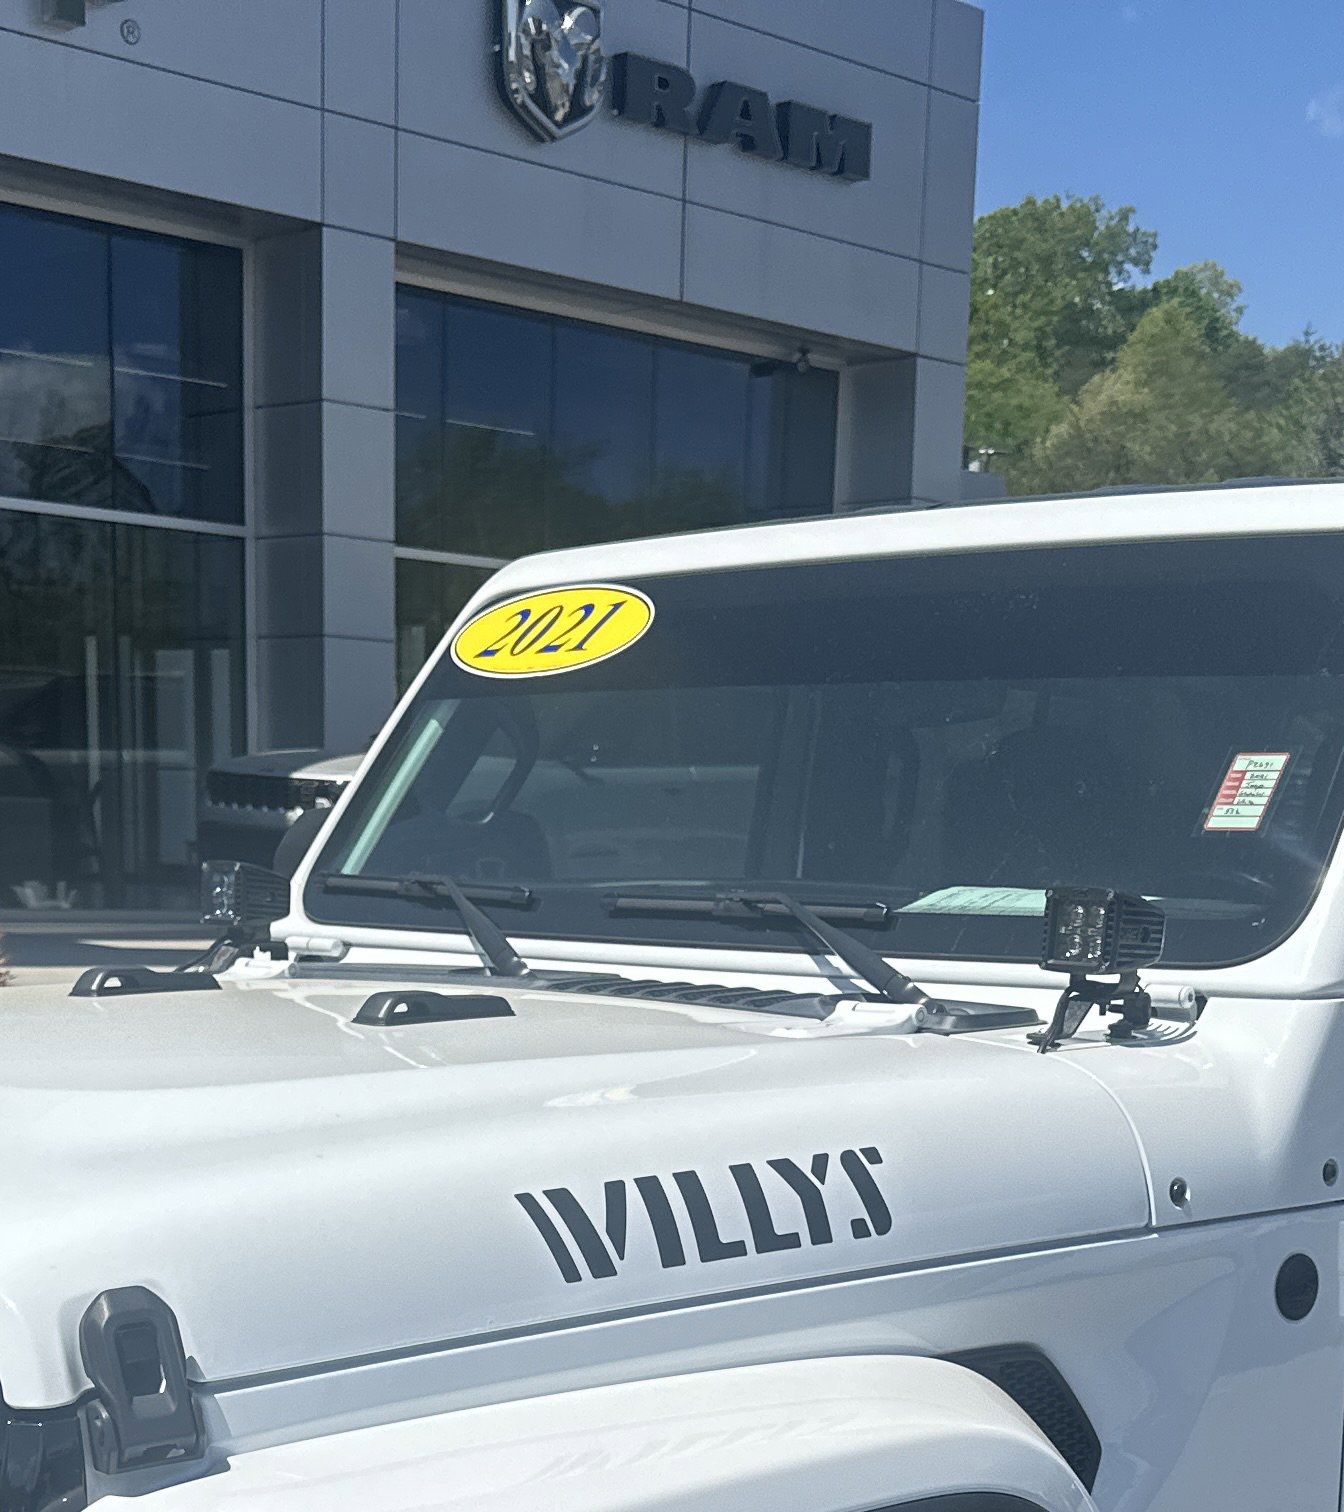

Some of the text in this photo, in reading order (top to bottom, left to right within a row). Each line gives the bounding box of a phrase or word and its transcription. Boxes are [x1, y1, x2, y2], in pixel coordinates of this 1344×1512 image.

[611, 52, 872, 181] RAM
[473, 600, 628, 659] 2021
[514, 1147, 892, 1283] WILLYS
